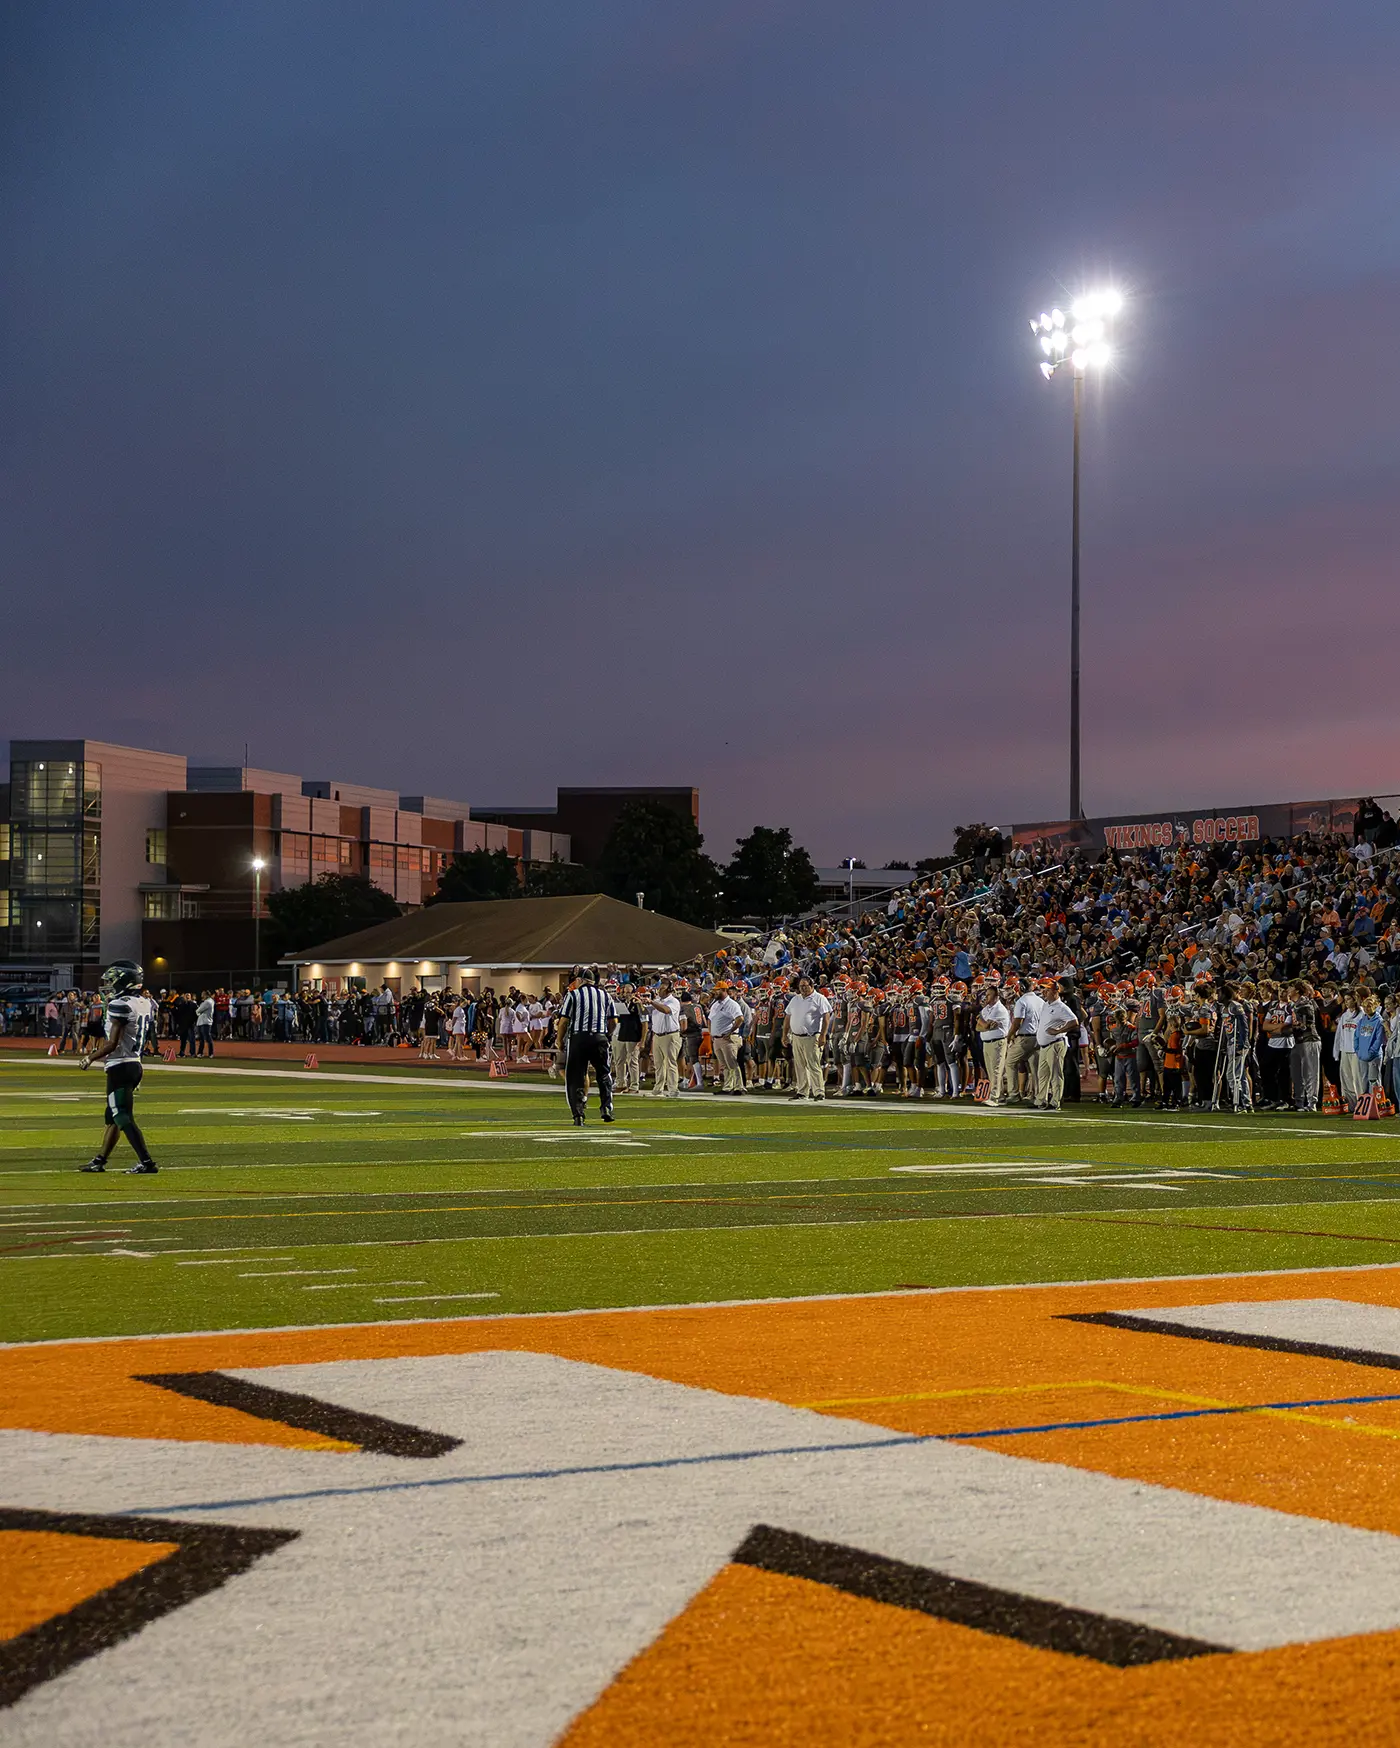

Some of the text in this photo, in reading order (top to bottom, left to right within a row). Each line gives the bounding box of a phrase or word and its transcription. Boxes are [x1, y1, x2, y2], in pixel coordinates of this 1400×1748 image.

[1104, 815, 1260, 849] VIKINGS SOCCER
[495, 1061, 508, 1075] 50
[975, 1080, 990, 1101] 30
[1355, 1096, 1371, 1116] 20
